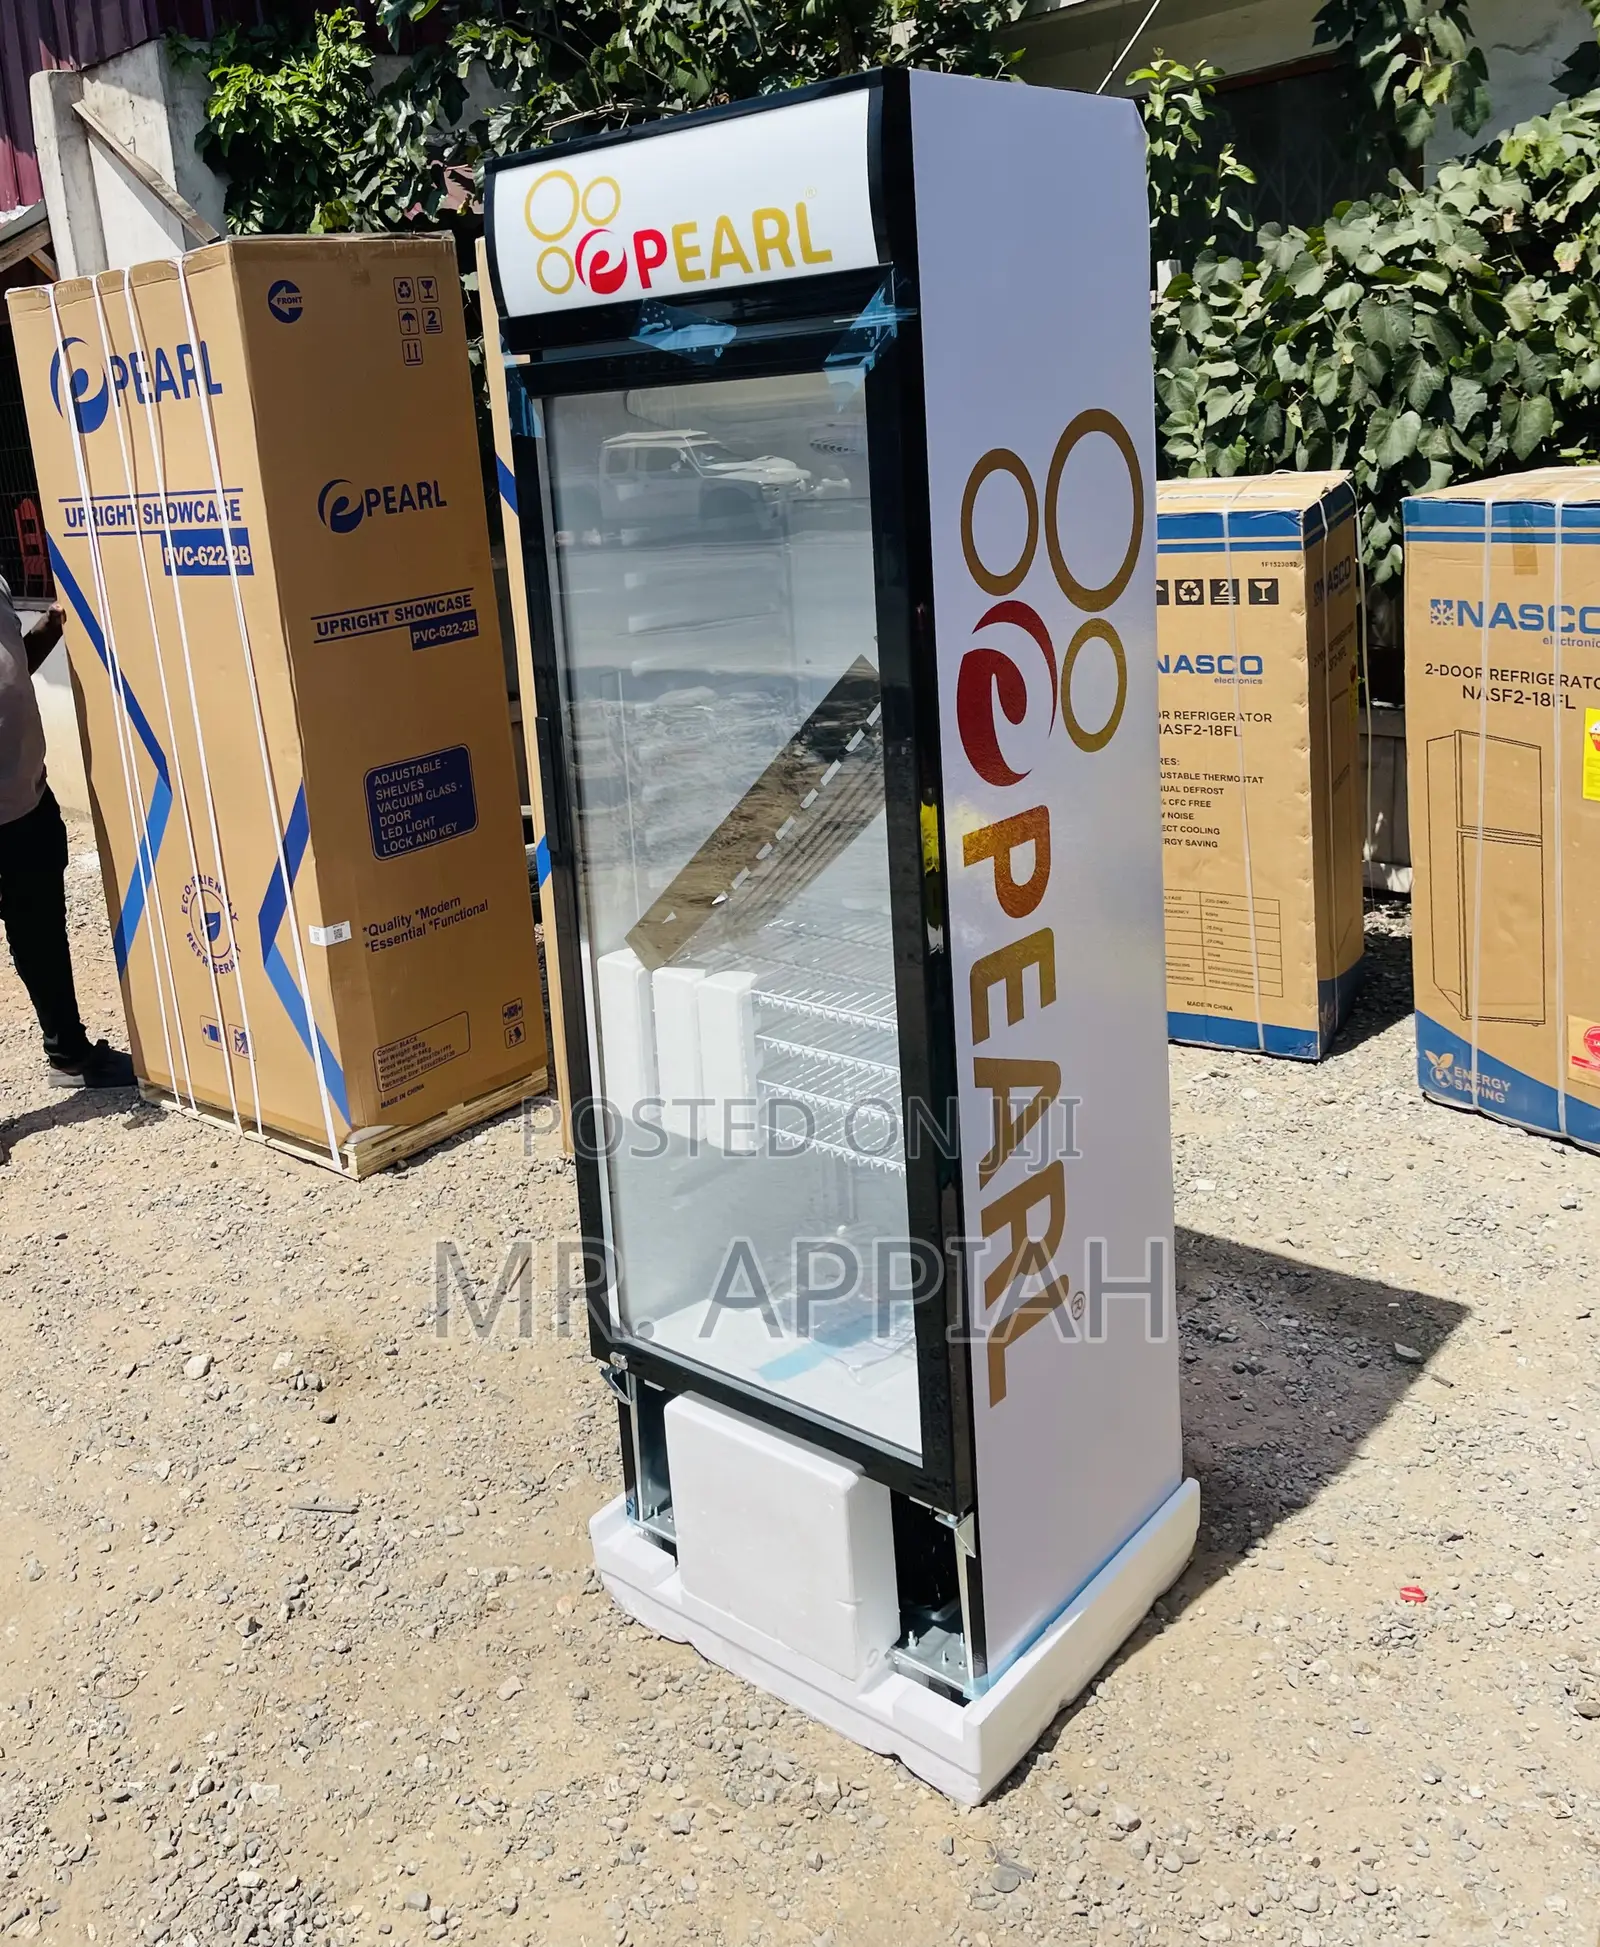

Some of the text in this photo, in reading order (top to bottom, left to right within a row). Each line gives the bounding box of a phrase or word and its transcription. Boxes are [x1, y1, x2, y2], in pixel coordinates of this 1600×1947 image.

[633, 201, 833, 289] PEARL
[277, 296, 302, 305] FRONT
[108, 340, 223, 407] PEARL
[365, 480, 447, 517] PEARL
[65, 499, 242, 528] UPRIGHT SHOWCASE
[316, 594, 472, 636] UPRIGHT SHOWCASE
[1457, 600, 1600, 635] NASCO
[412, 619, 477, 645] PVC-622-2B
[1542, 635, 1600, 649] elctronic
[1425, 663, 1482, 679] 2-DOOR
[1462, 685, 1577, 710] NASF2-18FL
[1174, 710, 1273, 723] REFRIGERATOR
[374, 758, 442, 786] ADJUSTABLE
[375, 779, 425, 801] SHELVES
[377, 781, 458, 814] VACUUM GLASS
[1183, 786, 1225, 795] DEFROST
[1167, 812, 1195, 820] NOISE
[1188, 800, 1212, 808] FREE
[379, 809, 412, 828] DOOR
[381, 815, 436, 841] LED LIGHT
[1180, 825, 1221, 835] COOLING
[383, 821, 458, 854] LOCK AND KEY
[1185, 839, 1219, 848] SAVING
[1454, 1066, 1511, 1092] ENERGY
[380, 1084, 425, 1109] MADE IN CHINA
[963, 804, 1069, 1410] PEARL
